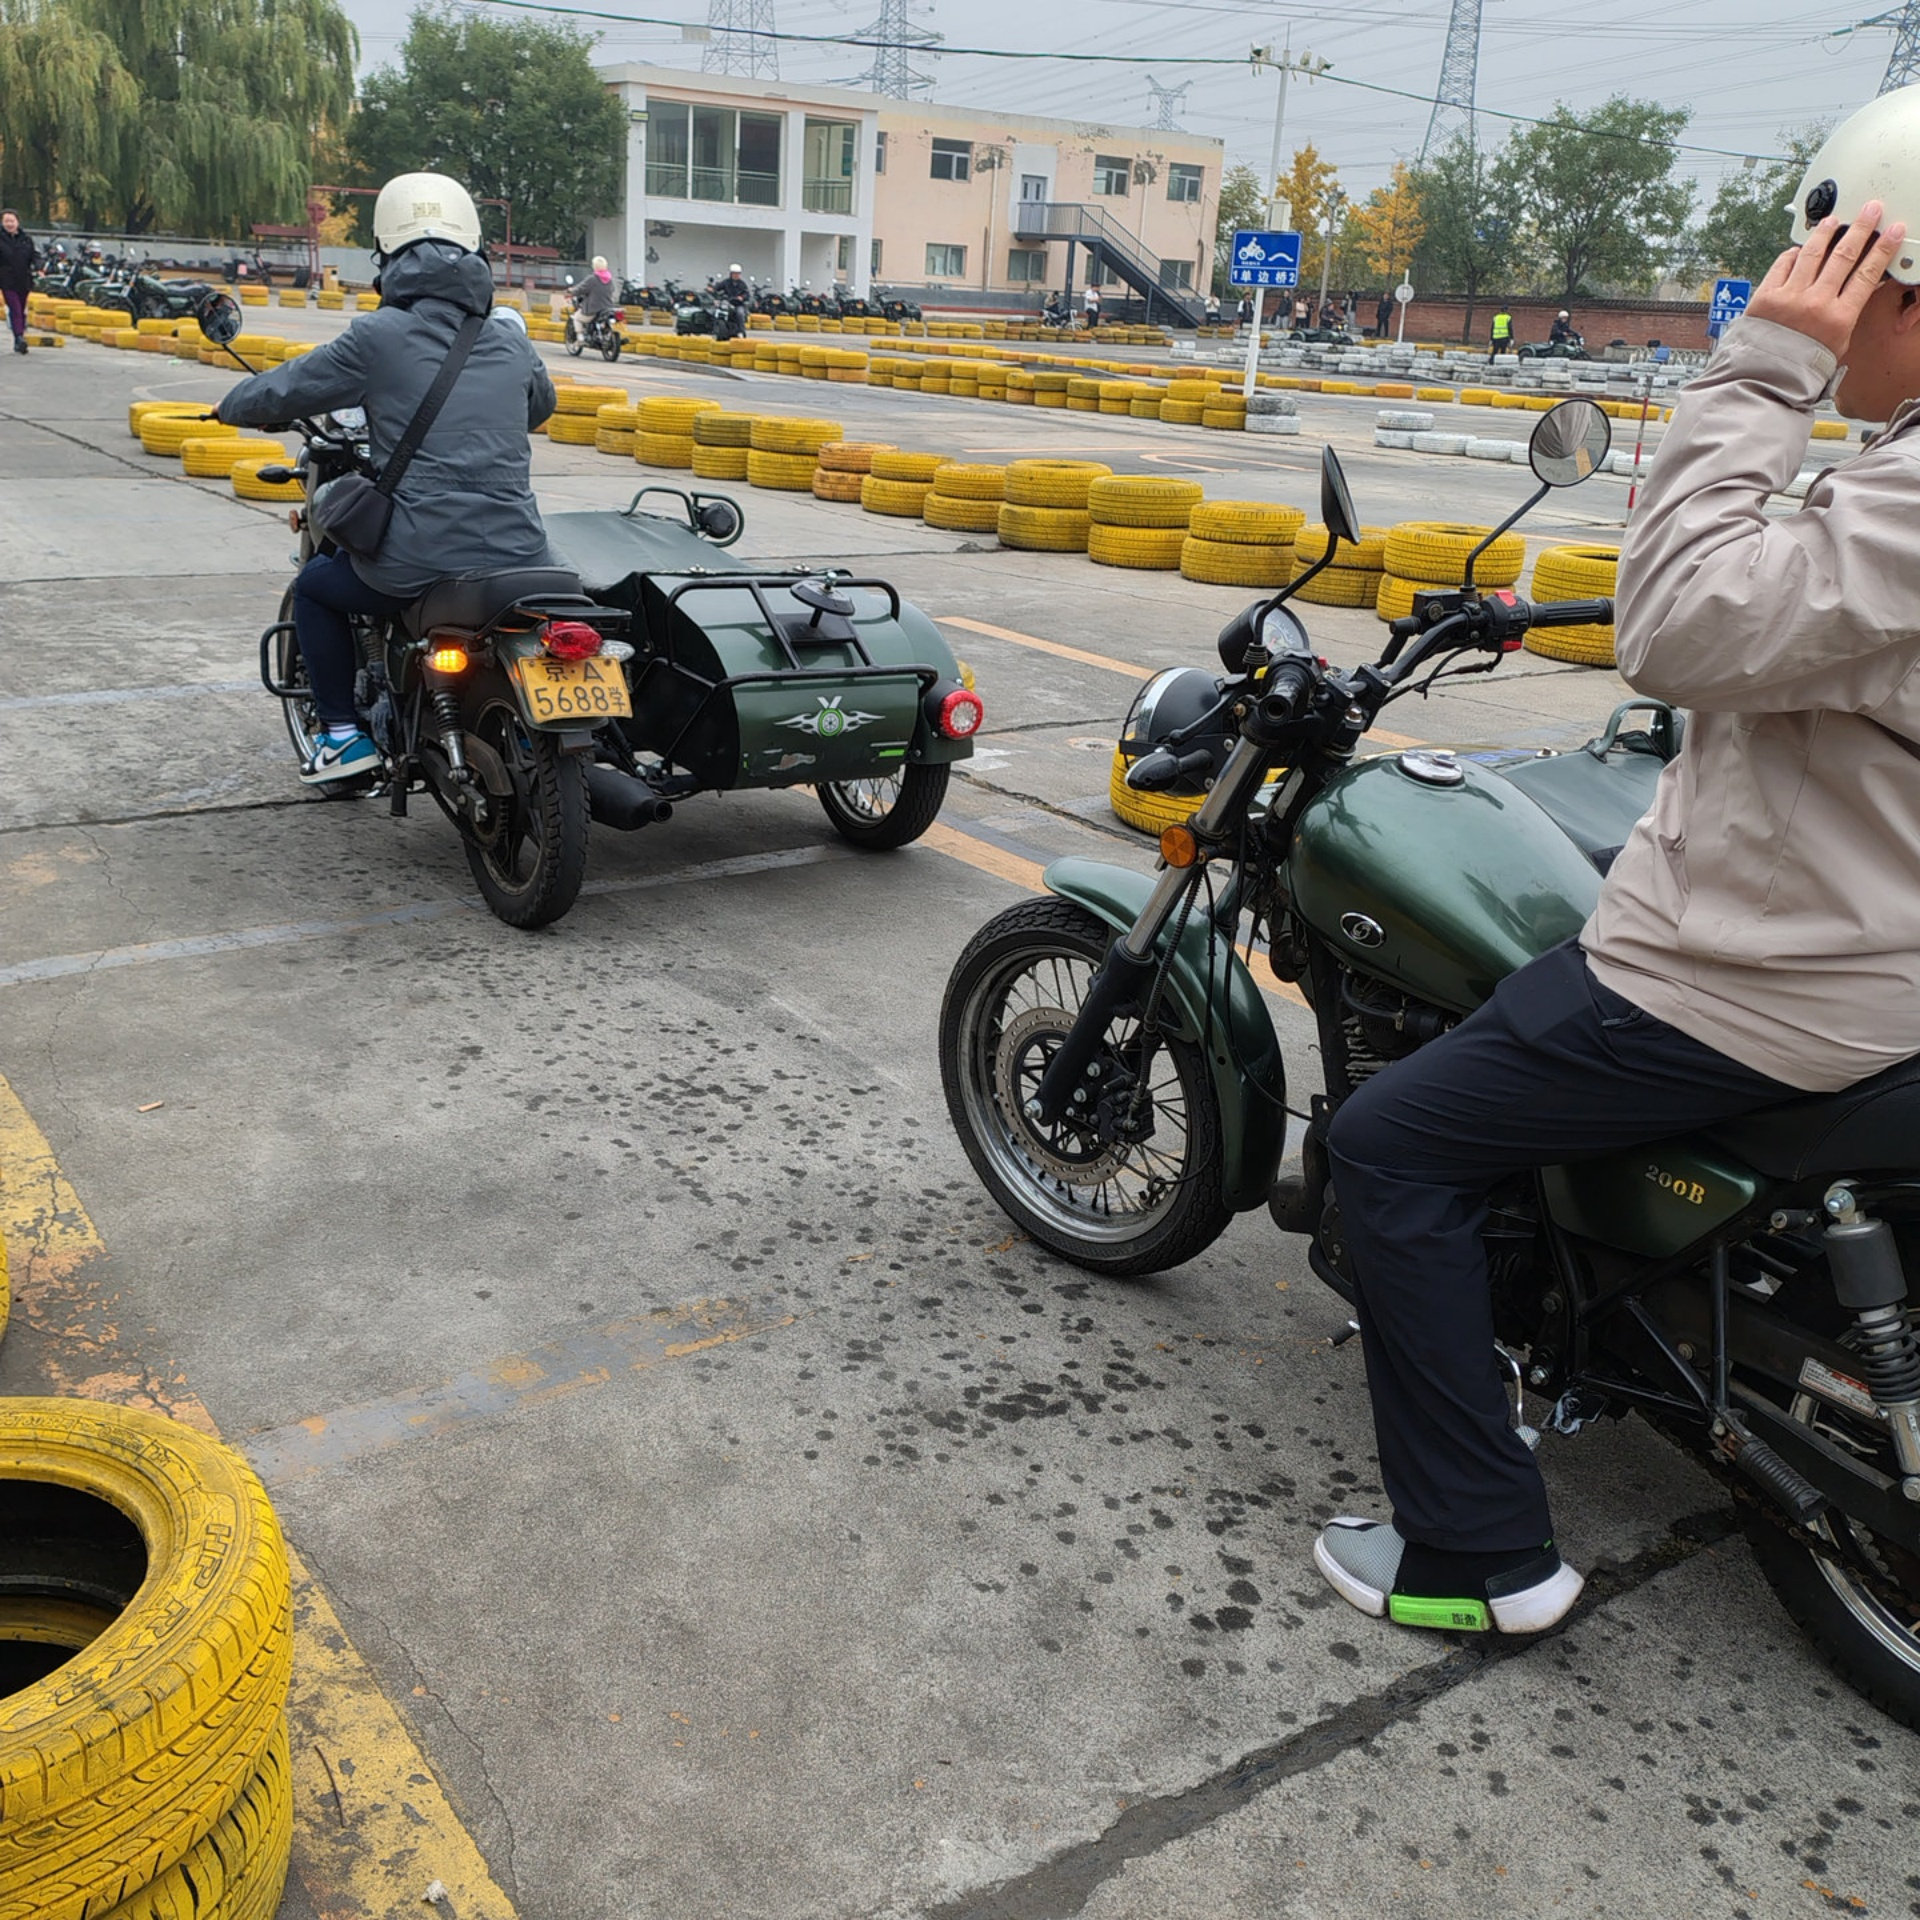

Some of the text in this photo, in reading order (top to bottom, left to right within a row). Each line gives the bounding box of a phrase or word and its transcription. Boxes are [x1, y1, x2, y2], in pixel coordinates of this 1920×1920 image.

[534, 686, 626, 716] 5688学
[1645, 1164, 1705, 1205] 200B
[194, 1523, 232, 1589] HP
